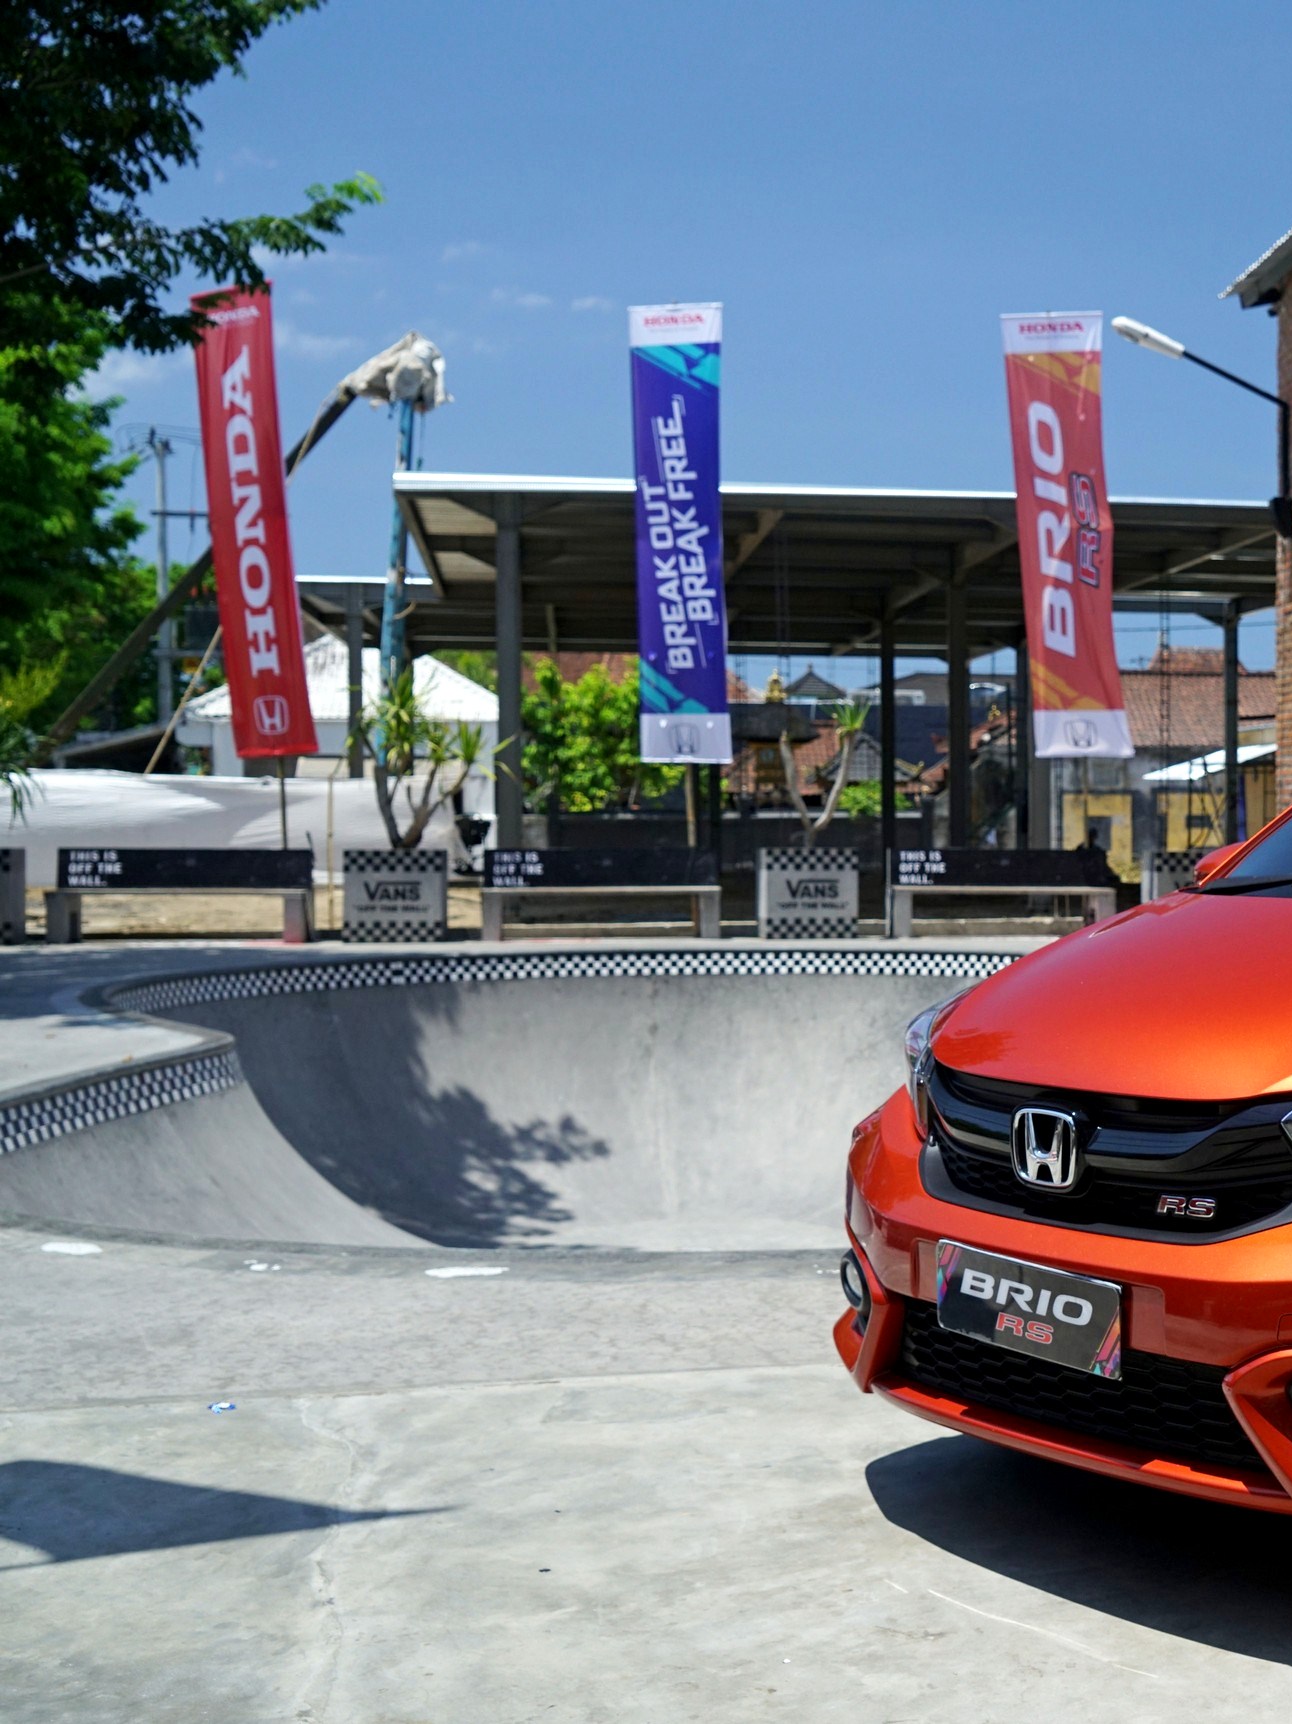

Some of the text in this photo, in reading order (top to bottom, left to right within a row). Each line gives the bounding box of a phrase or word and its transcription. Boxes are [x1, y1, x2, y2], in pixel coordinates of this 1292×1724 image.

[643, 313, 704, 327] HONDA
[1019, 321, 1084, 335] HONDA
[220, 345, 280, 679] HONDA
[657, 400, 715, 622] BREAK FREE
[1028, 400, 1076, 657] BRIO
[1070, 471, 1099, 588] RS
[643, 483, 696, 670] BREAK OUT
[103, 850, 118, 862] IS
[900, 850, 942, 862] THIS IS
[68, 862, 123, 875] OFF THE
[899, 862, 946, 873] OFF THE
[364, 881, 422, 901] VANS
[786, 879, 839, 899] VANS
[1156, 1194, 1216, 1218] RS
[959, 1268, 1093, 1327] BRIO
[995, 1312, 1054, 1344] RS
